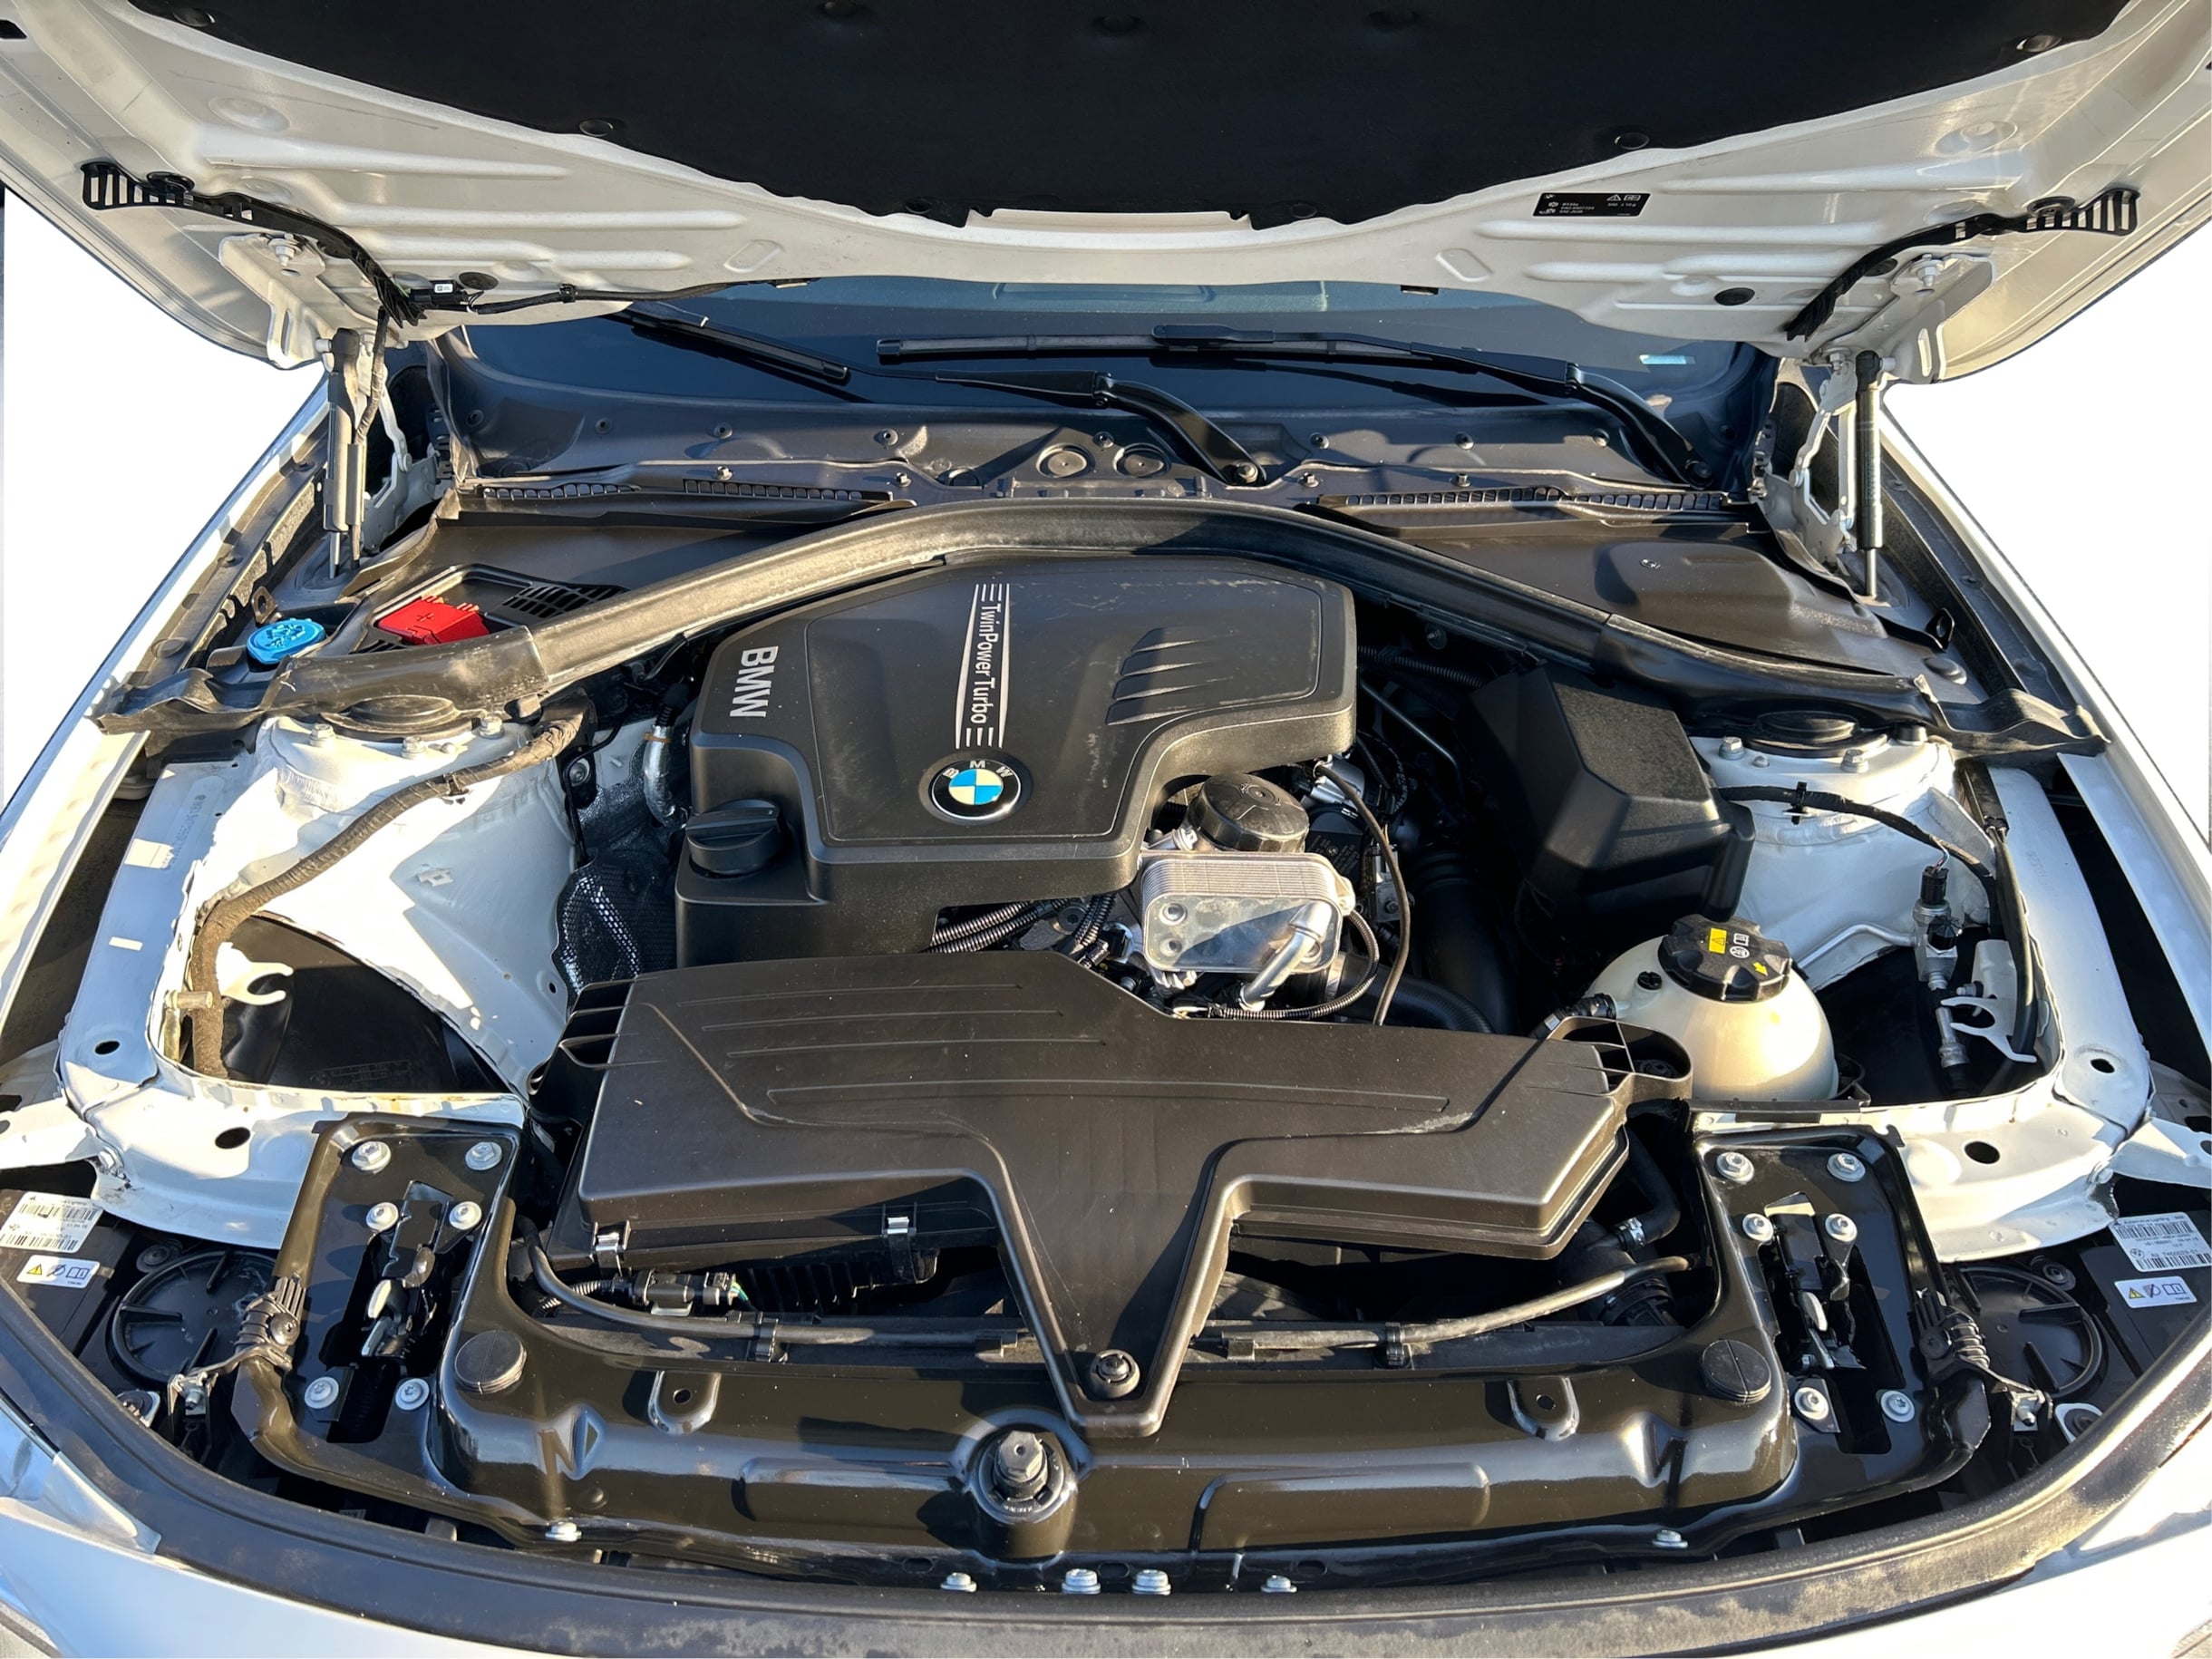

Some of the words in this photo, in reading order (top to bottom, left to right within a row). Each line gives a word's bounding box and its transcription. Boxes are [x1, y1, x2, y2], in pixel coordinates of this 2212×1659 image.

[975, 603, 1002, 677] TwinPower
[729, 645, 779, 718] BMW
[970, 677, 996, 724] Turbo
[943, 760, 1014, 780] BMW
